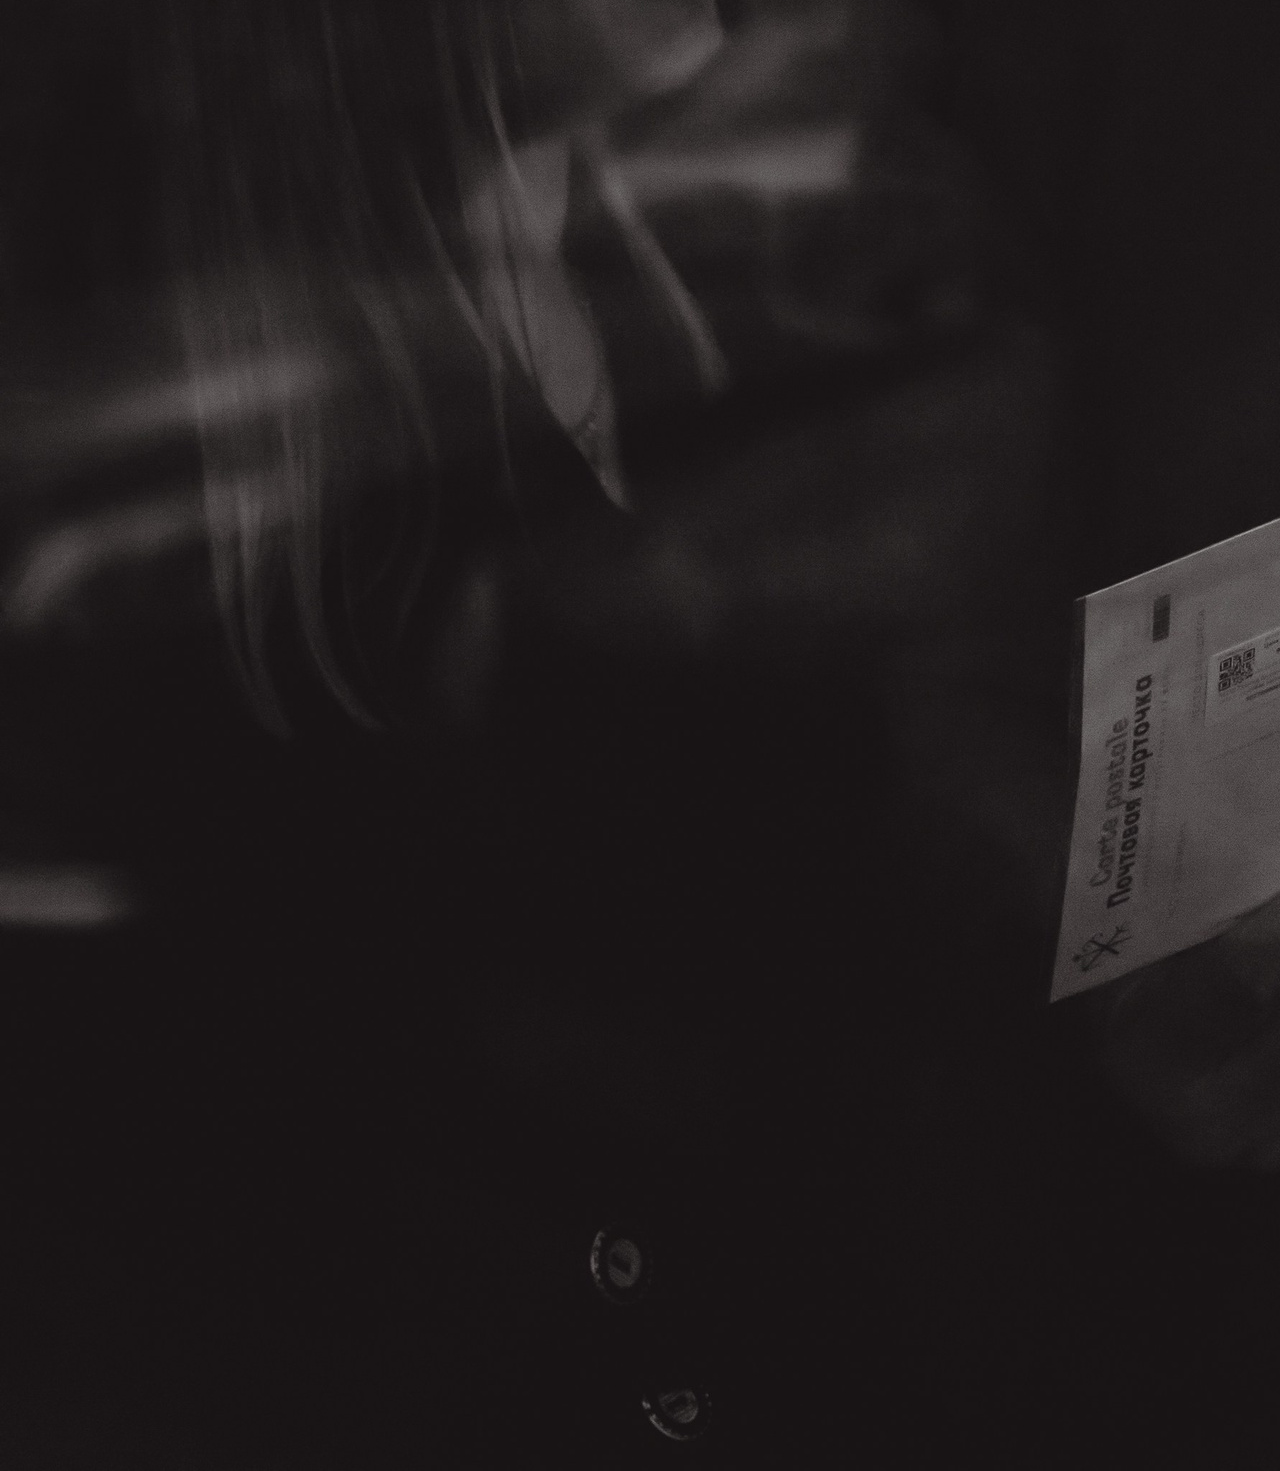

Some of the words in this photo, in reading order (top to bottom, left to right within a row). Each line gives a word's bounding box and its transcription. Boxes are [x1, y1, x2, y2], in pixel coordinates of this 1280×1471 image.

[1104, 717, 1128, 812] postale
[1106, 797, 1140, 909] Почтовая
[1129, 672, 1154, 795] карточка
[1089, 817, 1120, 889] Carte
